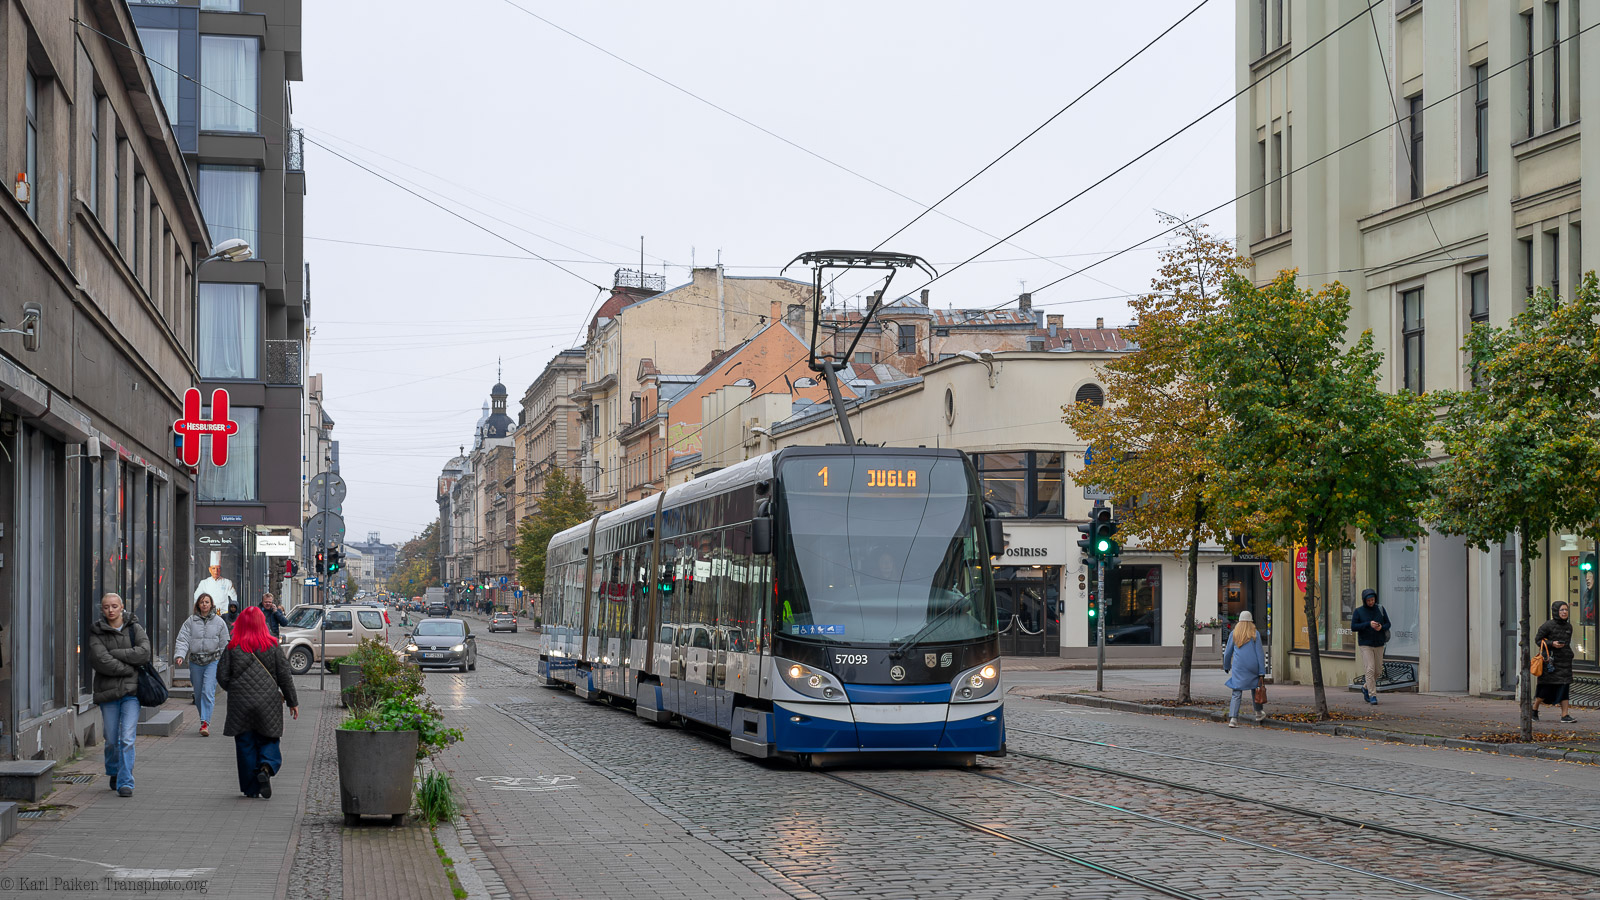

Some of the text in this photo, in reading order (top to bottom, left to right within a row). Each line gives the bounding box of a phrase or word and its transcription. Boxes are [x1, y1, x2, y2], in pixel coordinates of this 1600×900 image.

[186, 422, 226, 432] HESBURGER
[817, 466, 829, 487] 1
[867, 469, 917, 487] JUGLA
[835, 654, 868, 664] 57093
